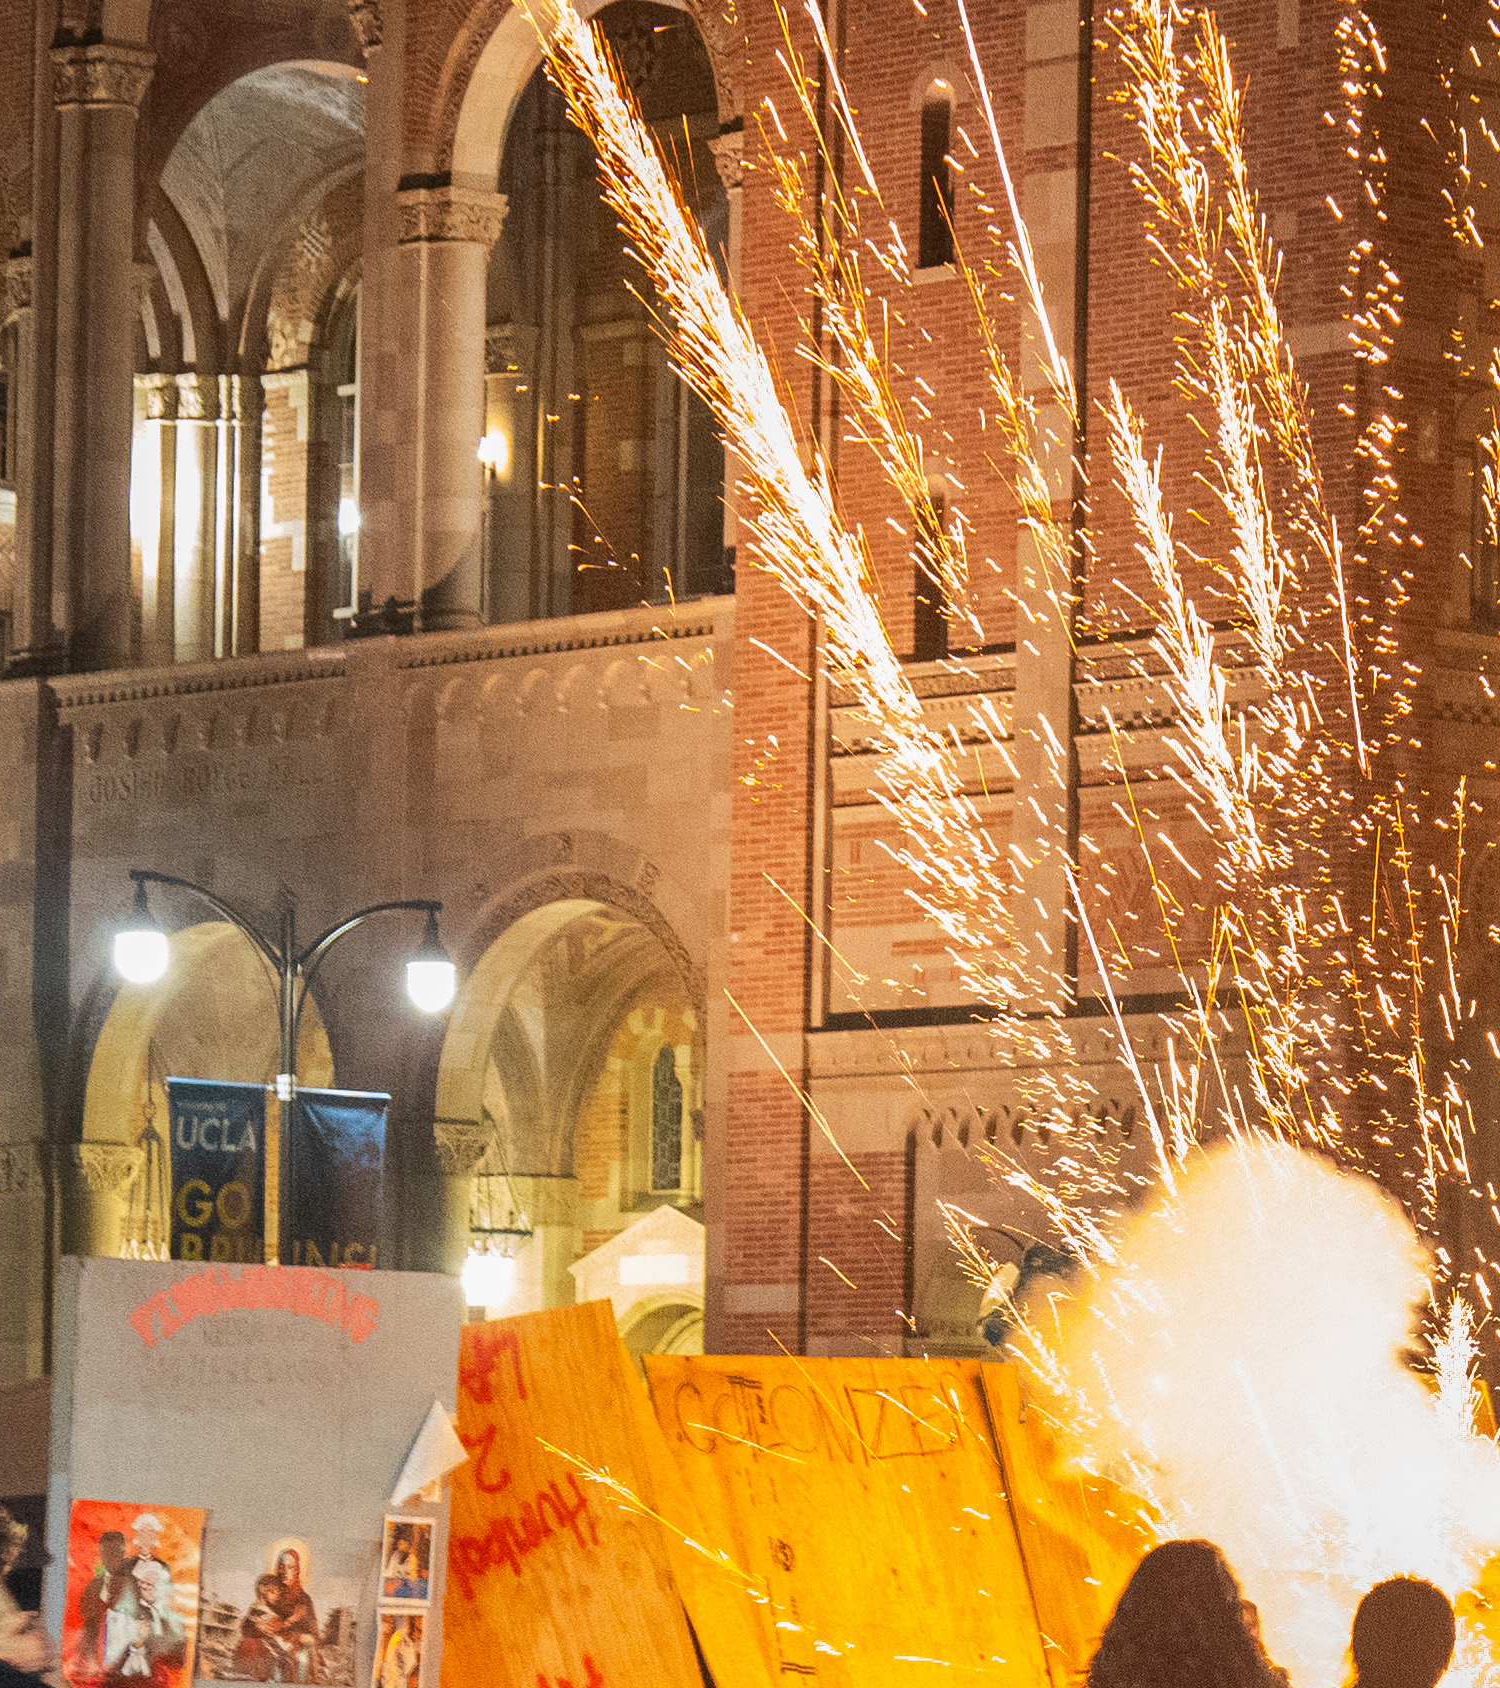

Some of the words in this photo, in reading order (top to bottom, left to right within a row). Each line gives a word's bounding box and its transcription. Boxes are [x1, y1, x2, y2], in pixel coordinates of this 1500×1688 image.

[176, 1115, 258, 1154] UCLA
[177, 1179, 252, 1229] GO
[460, 1424, 512, 1494] 2
